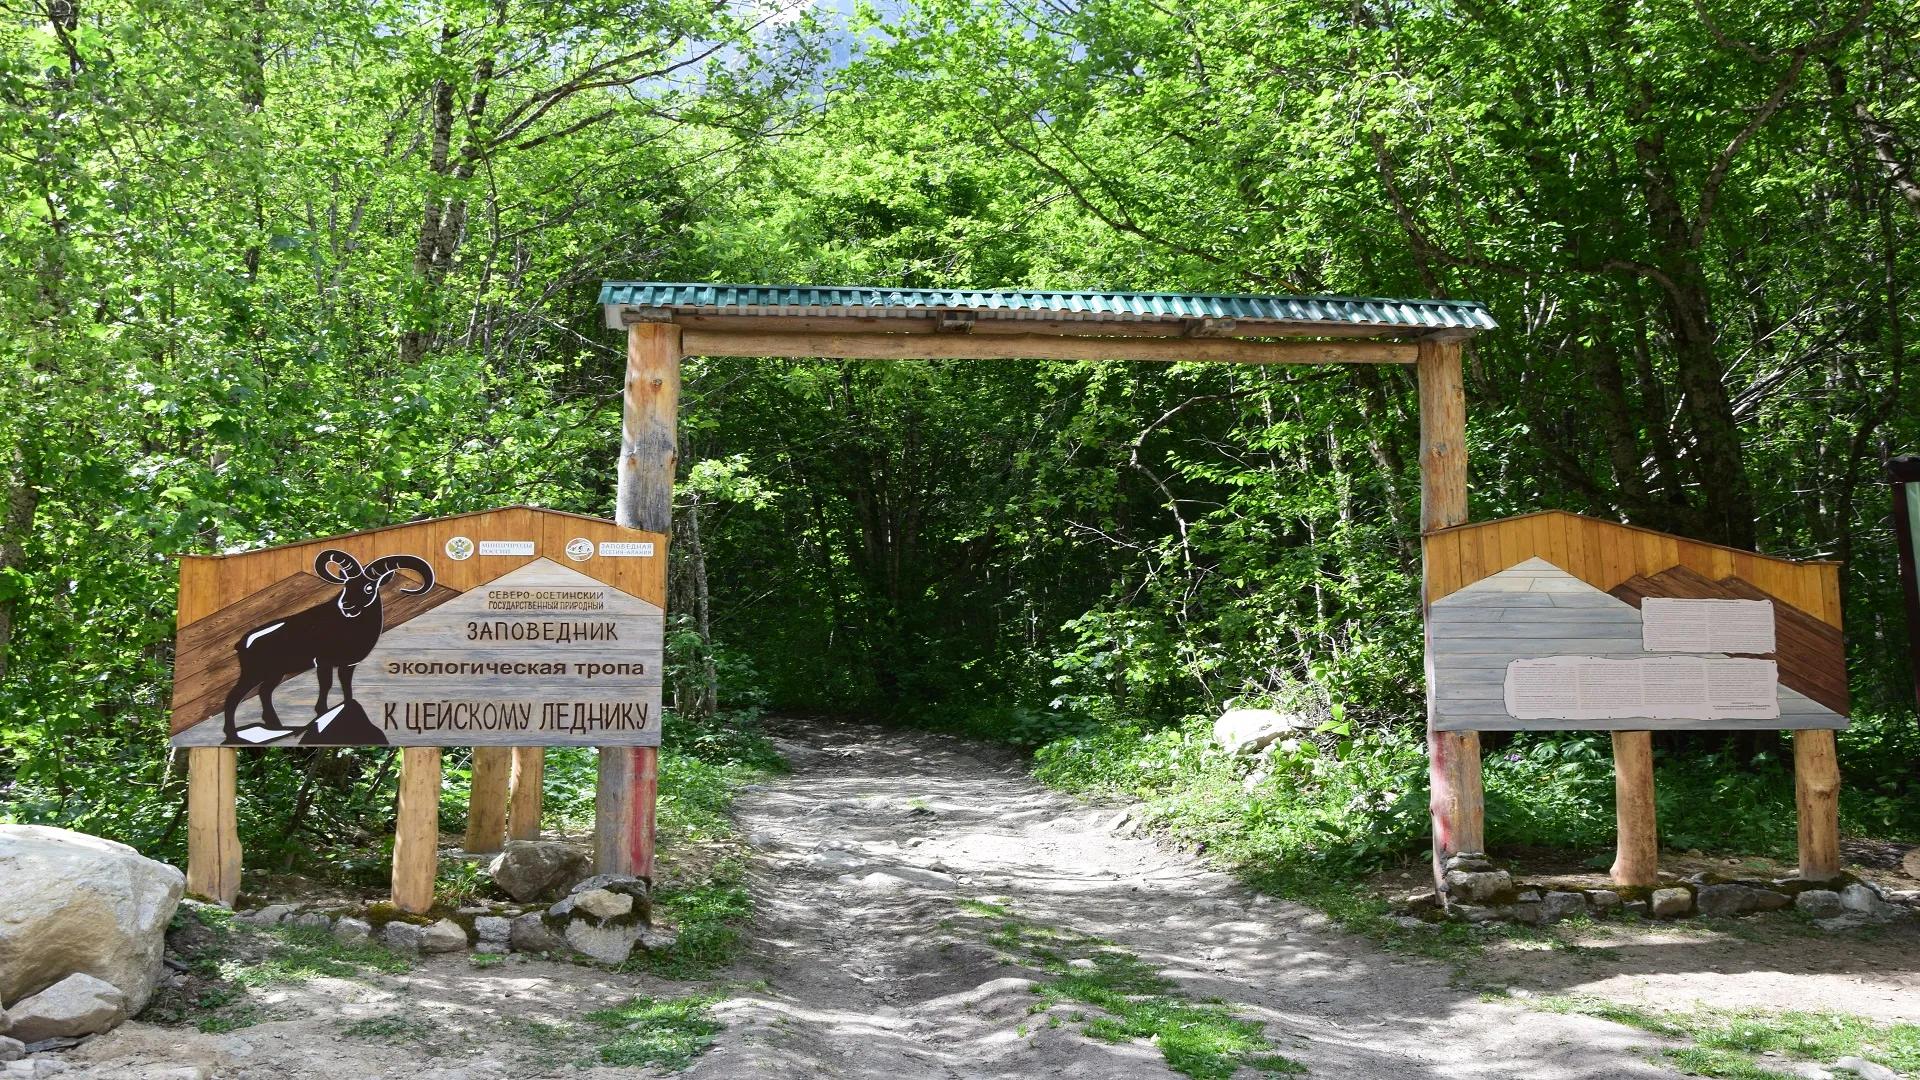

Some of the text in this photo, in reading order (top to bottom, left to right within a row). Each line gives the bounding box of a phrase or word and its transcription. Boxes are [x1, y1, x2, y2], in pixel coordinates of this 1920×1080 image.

[466, 622, 618, 643] ЗАПОВЕДНИК
[388, 661, 645, 678] экологическая тропа
[384, 700, 649, 734] К ЦЕЙСКОМУ ЛЕДНИКУ
